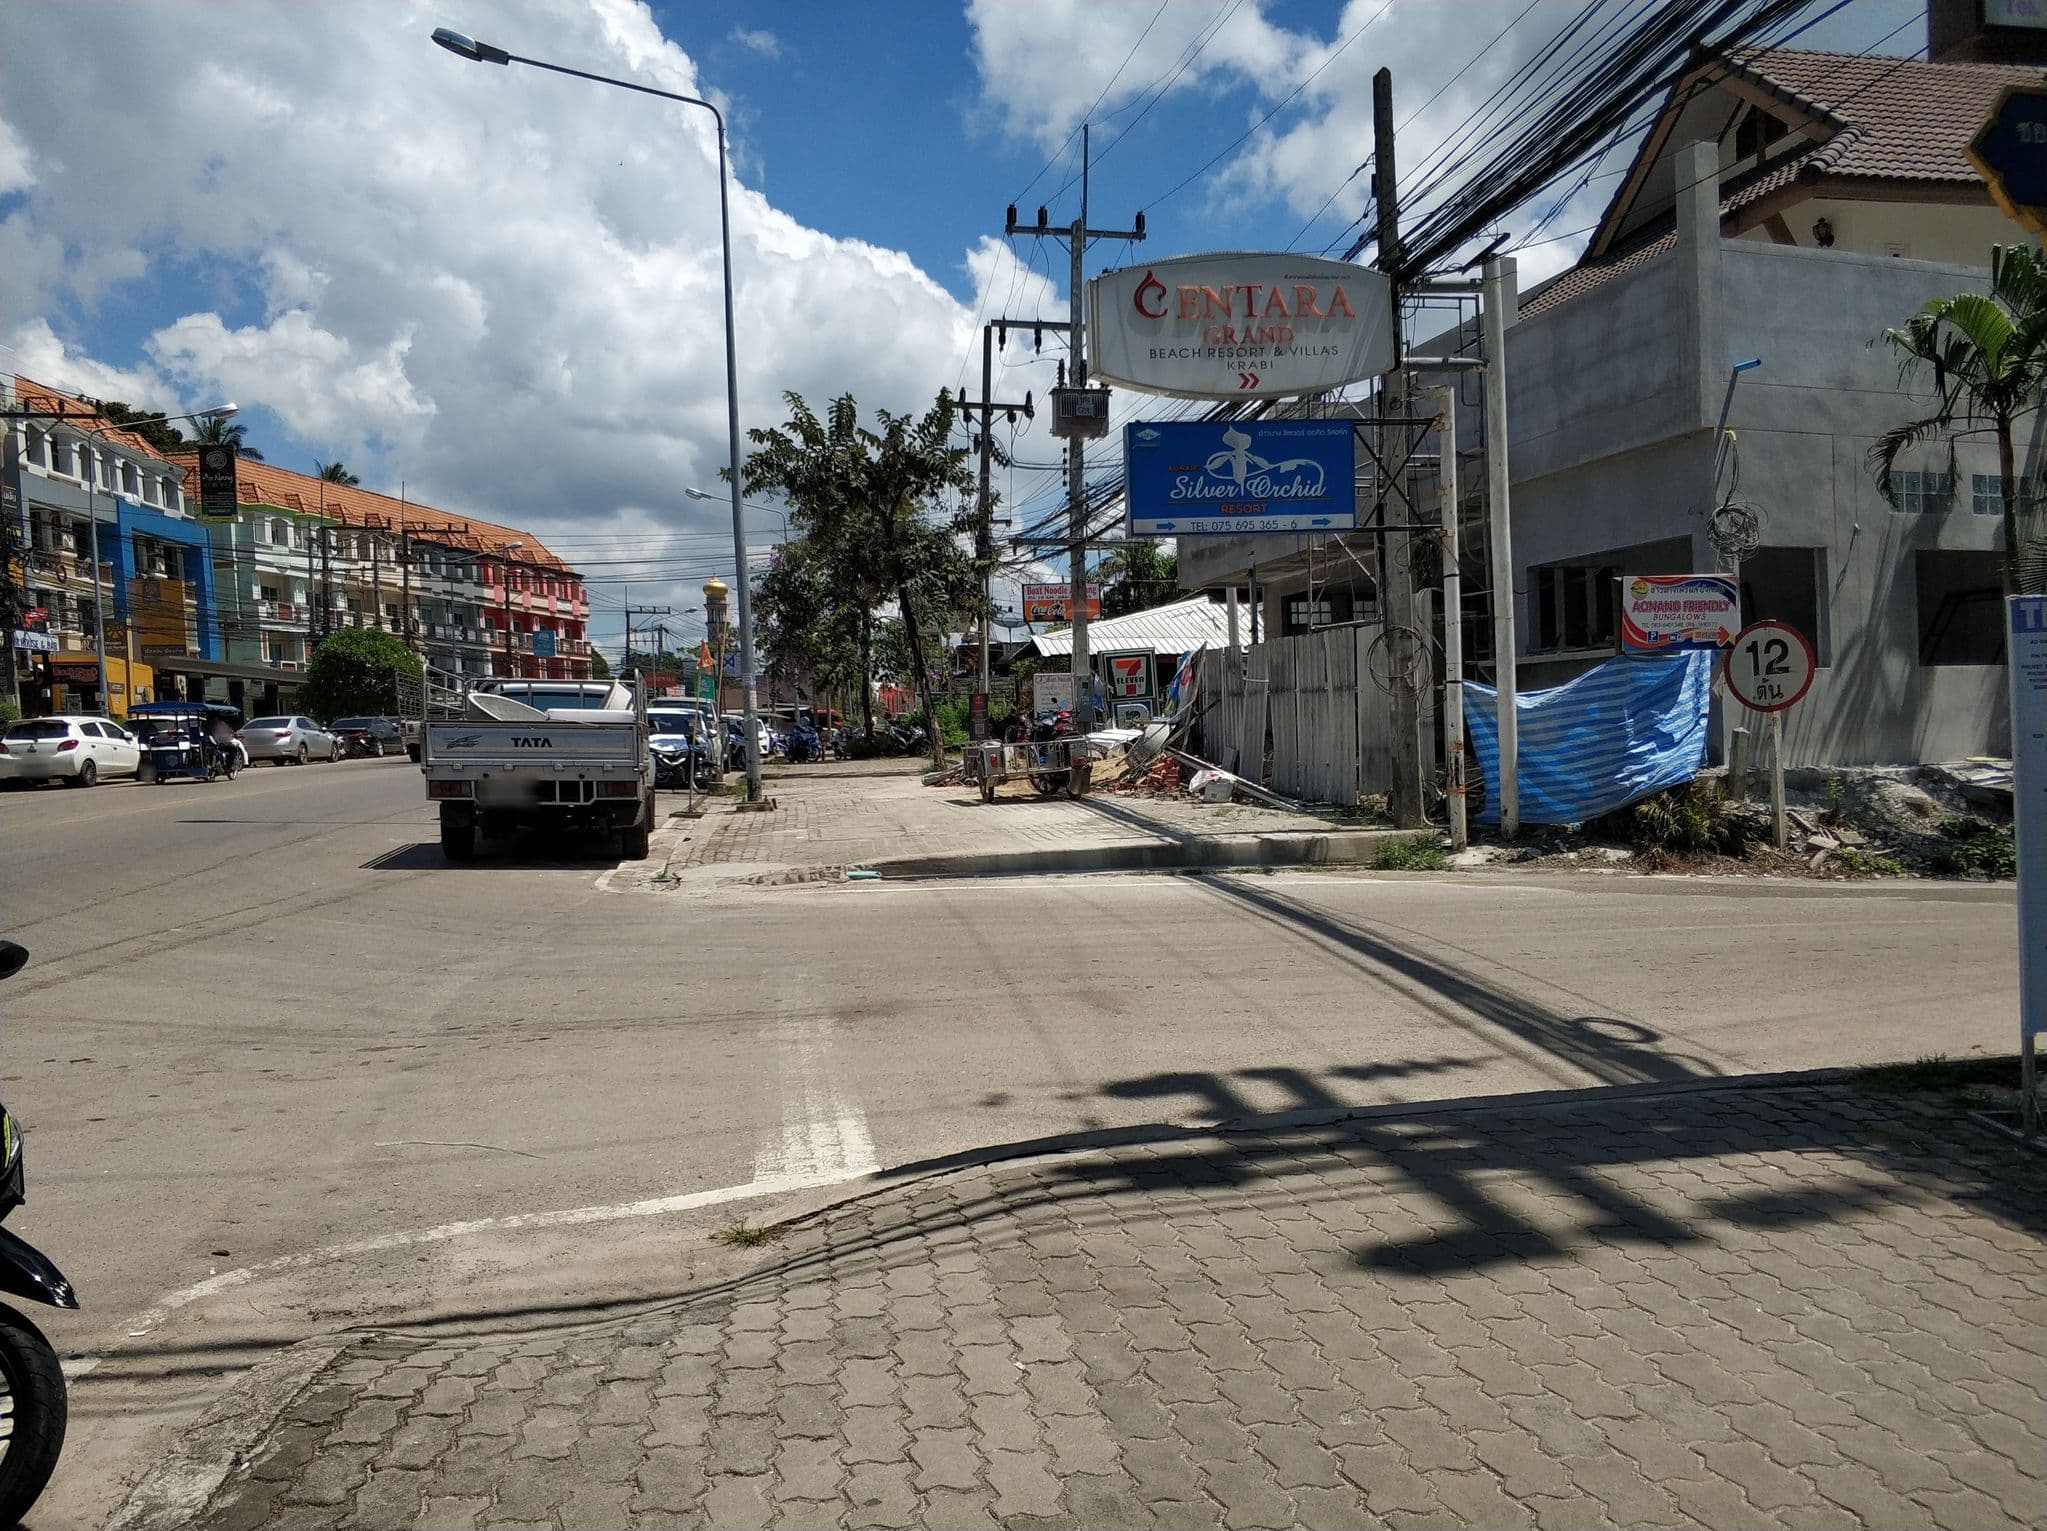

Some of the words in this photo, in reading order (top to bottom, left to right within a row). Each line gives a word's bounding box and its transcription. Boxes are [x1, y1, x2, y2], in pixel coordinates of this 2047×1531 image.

[1134, 270, 1355, 320] CENTARA
[1203, 325, 1296, 345] GRAND
[1149, 348, 1201, 360] BEACH
[1207, 347, 1265, 359] RESORT
[1274, 346, 1284, 358] &
[1289, 345, 1340, 357] VILLAS
[1226, 360, 1274, 371] KRABI
[1169, 475, 1240, 499] Silver
[1246, 475, 1328, 498] Orchid
[1219, 503, 1268, 514] RESORT
[1211, 520, 1232, 531] 075
[1235, 520, 1255, 531] 695
[1259, 519, 1278, 530] 365
[1290, 519, 1298, 530] 6
[1027, 586, 1042, 595] Boat
[1044, 586, 1067, 595] Noodle
[1632, 600, 1681, 613] AONANG
[1682, 599, 1731, 613] FRIENDLY
[1653, 613, 1706, 621] BUNGALOWS
[1745, 638, 1790, 677] 12
[1116, 659, 1142, 695] 7
[1757, 678, 1784, 700] ตัน
[511, 736, 553, 748] TATA
